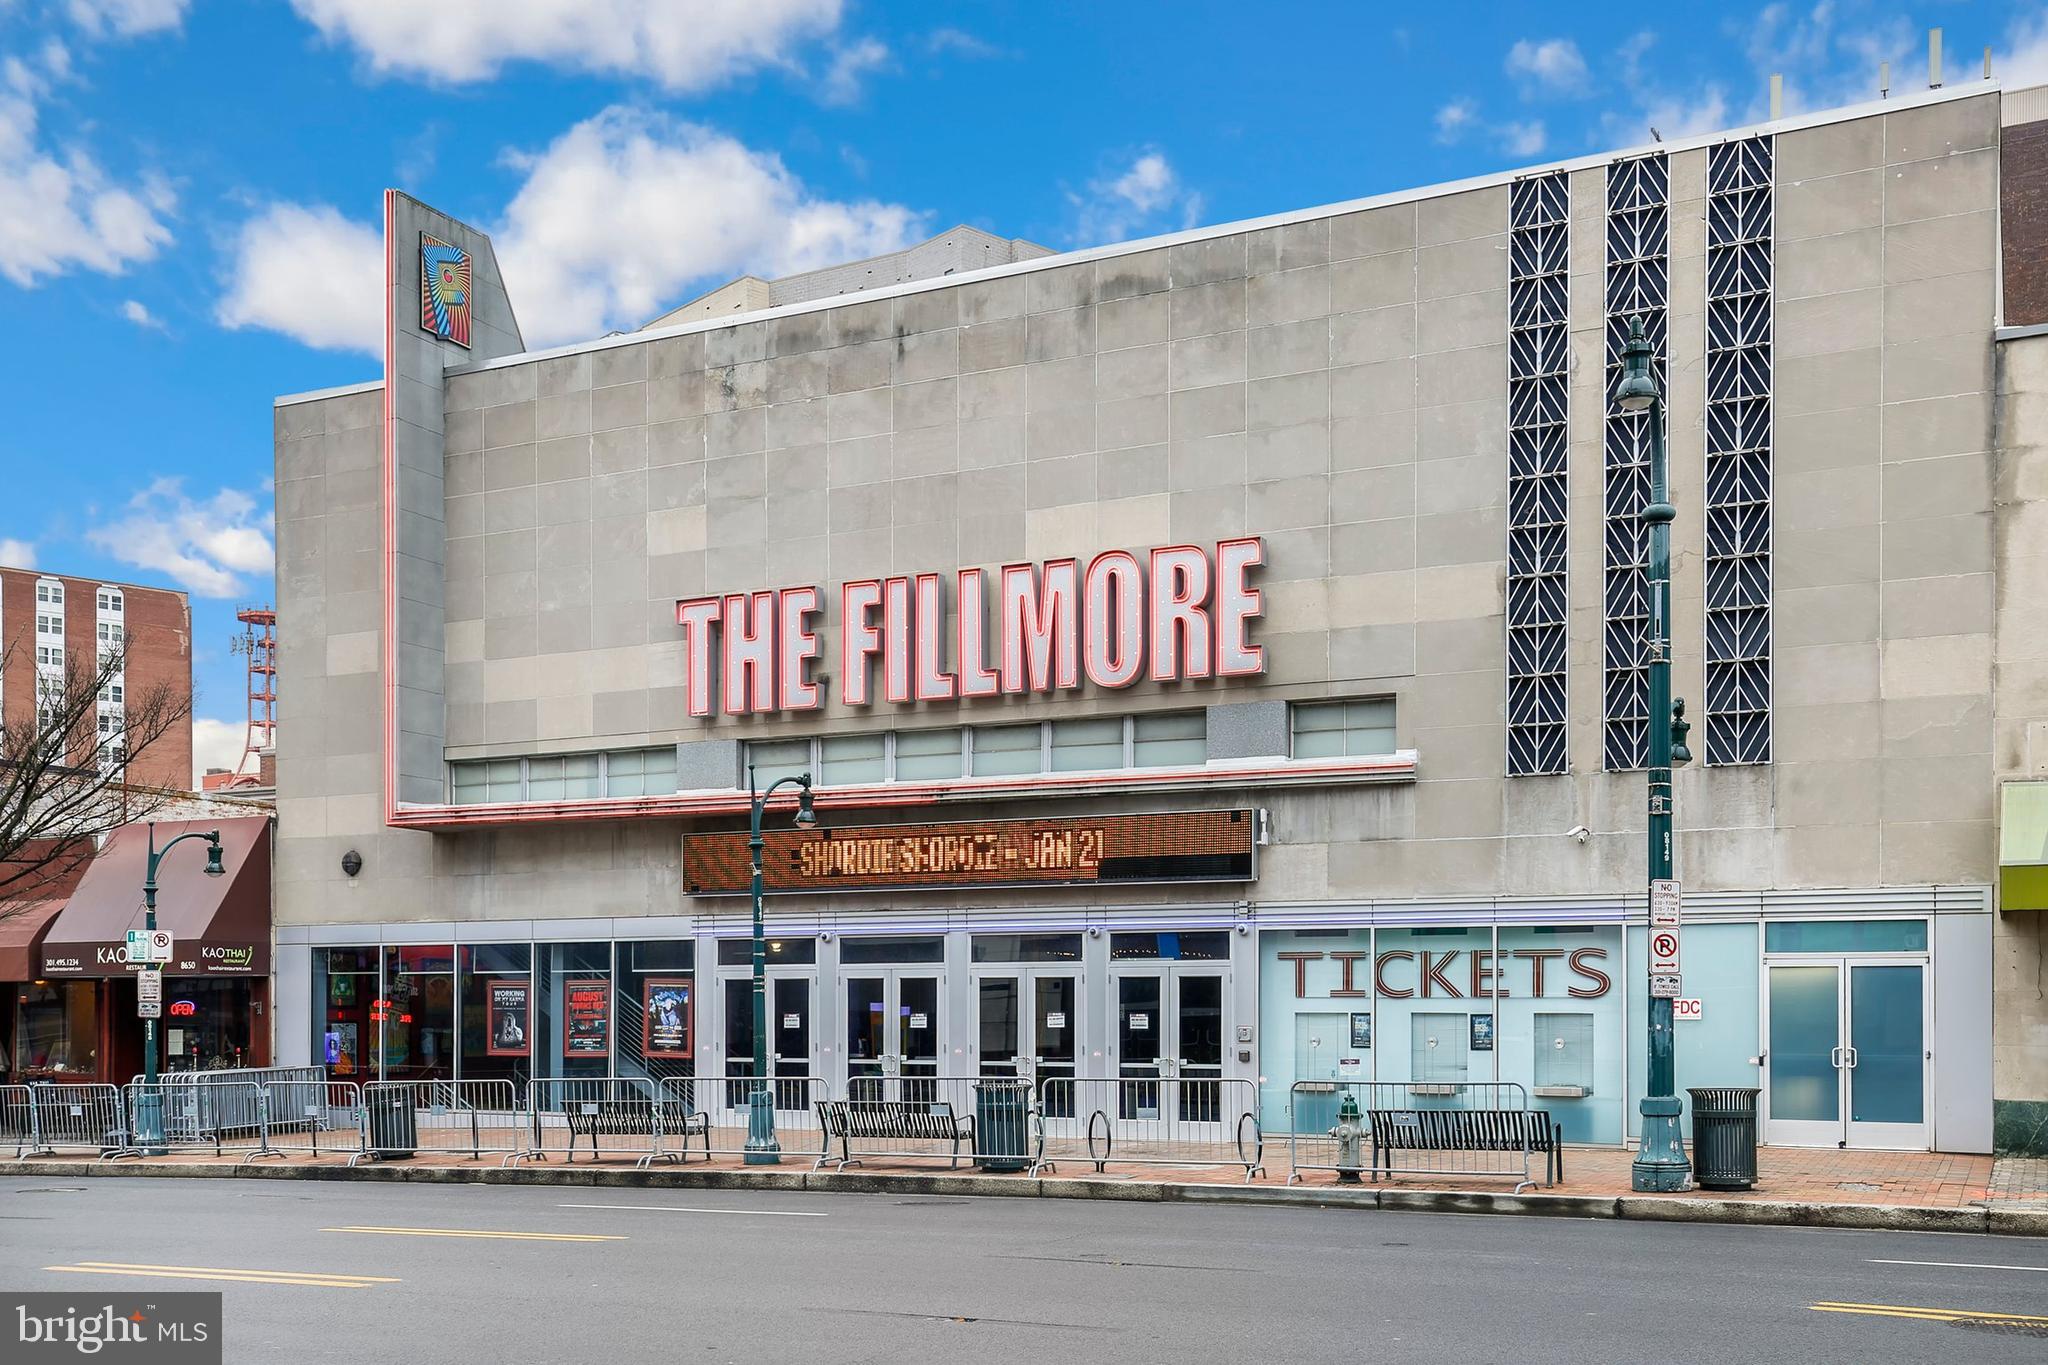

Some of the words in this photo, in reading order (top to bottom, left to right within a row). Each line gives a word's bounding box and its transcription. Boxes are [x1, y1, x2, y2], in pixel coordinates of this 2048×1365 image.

[676, 586, 824, 717] THE
[841, 536, 1268, 706] FILLMORE
[1025, 831, 1072, 868] JAN
[1079, 830, 1103, 867] 21
[46, 959, 79, 967] 301.495.1234
[180, 961, 196, 970] 8650
[1277, 947, 1612, 999] TICKETS
[494, 990, 525, 998] WORKING
[572, 991, 604, 1001] AUGUST
[170, 1004, 194, 1016] OPEN
[1673, 1000, 1700, 1014] FDC
